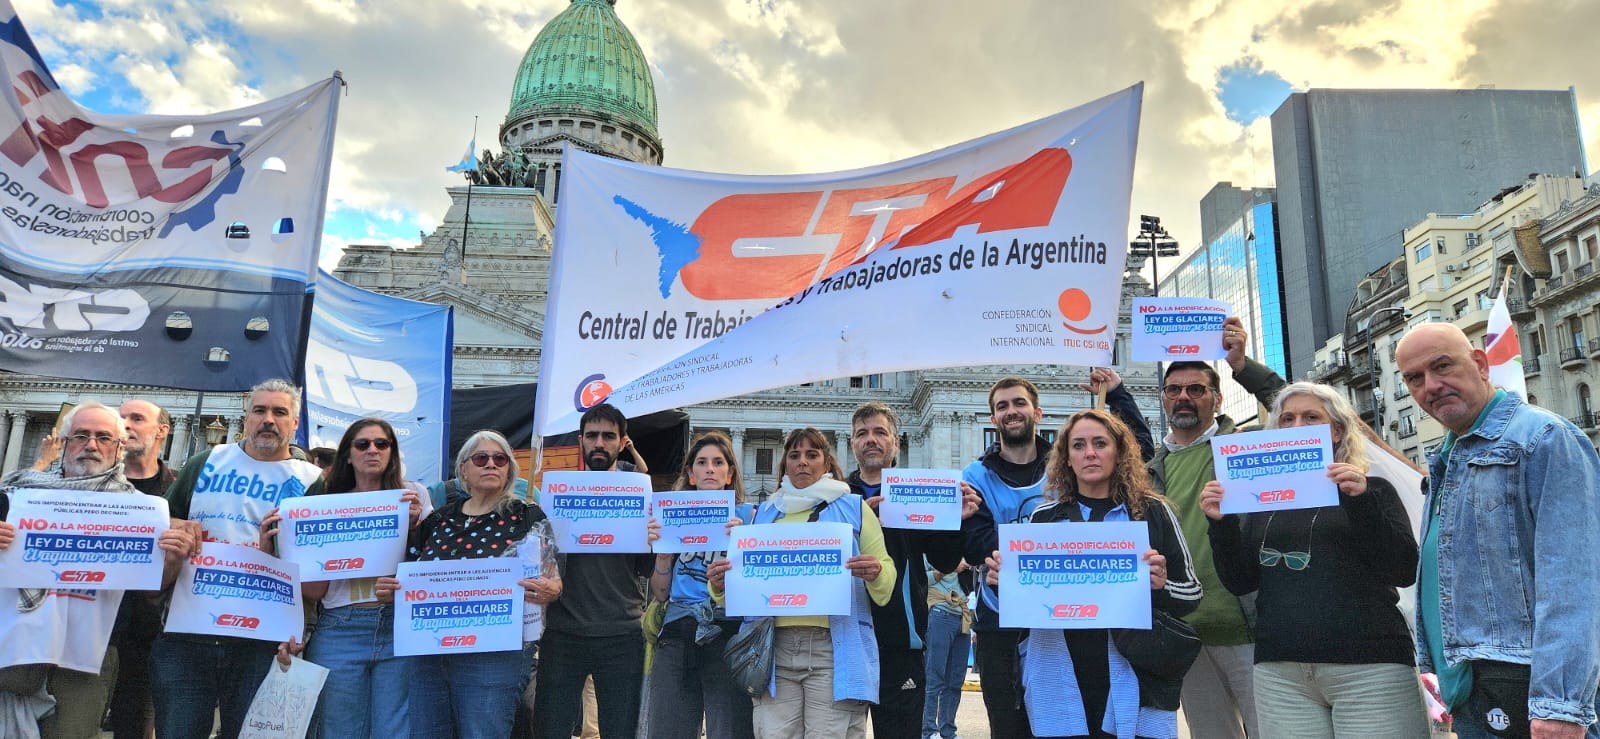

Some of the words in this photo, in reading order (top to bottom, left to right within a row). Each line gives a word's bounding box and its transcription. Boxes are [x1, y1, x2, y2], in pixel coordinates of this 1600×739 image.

[680, 148, 1072, 300] CTA
[578, 310, 648, 339] Central
[653, 311, 677, 339] de
[949, 244, 974, 270] de
[981, 240, 999, 267] la
[1006, 234, 1106, 269] Argentina
[982, 308, 1052, 320] CONFEDERACIÓN
[1016, 323, 1053, 332] SINDICAL
[990, 337, 1056, 347] INTERNACIONAL
[1064, 339, 1080, 347] ITUC
[687, 352, 720, 366] SINDICAL
[697, 356, 752, 375] TRABAJADORAS
[650, 382, 685, 397] AMÉRICAS
[1220, 444, 1239, 455] NO
[1259, 438, 1321, 449] MODIFICACIÓN
[1229, 459, 1244, 467] LEY
[1248, 457, 1259, 465] DE
[1262, 452, 1318, 464] GLACIARES
[194, 463, 278, 502] Suteba
[548, 484, 568, 493] NO
[289, 509, 311, 519] NO
[335, 505, 398, 514] MODIFICACIÓN
[19, 518, 48, 531] NO
[77, 524, 155, 533] MODIFICACIÓN
[297, 524, 316, 533] LEY
[319, 523, 332, 531] DE
[336, 519, 394, 530] GLACIARES
[27, 538, 52, 548] LEY
[56, 539, 72, 548] DE
[77, 540, 148, 550] GLACIARES
[308, 533, 339, 547] agua
[737, 538, 757, 549] NO
[1010, 539, 1034, 552] NO
[1061, 541, 1135, 549] MODIFICACIÓN
[40, 551, 80, 566] agua
[190, 556, 215, 566] NO
[745, 555, 762, 563] LEY
[765, 555, 778, 563] DE
[781, 554, 837, 563] GLACIARES
[1020, 560, 1040, 569] LEY
[1045, 560, 1060, 569] DE
[1064, 559, 1132, 569] GLACIARES
[755, 566, 784, 580] agua
[196, 572, 217, 582] LEY
[220, 575, 235, 584] DE
[238, 577, 290, 594] GLACIARES
[1033, 572, 1069, 589] agua
[405, 590, 427, 601] NO
[450, 587, 512, 597] MODIFICACIÓN
[413, 608, 431, 616] LEY
[435, 606, 448, 615] DE
[452, 604, 508, 614] GLACIARES
[1053, 604, 1098, 617] CTA
